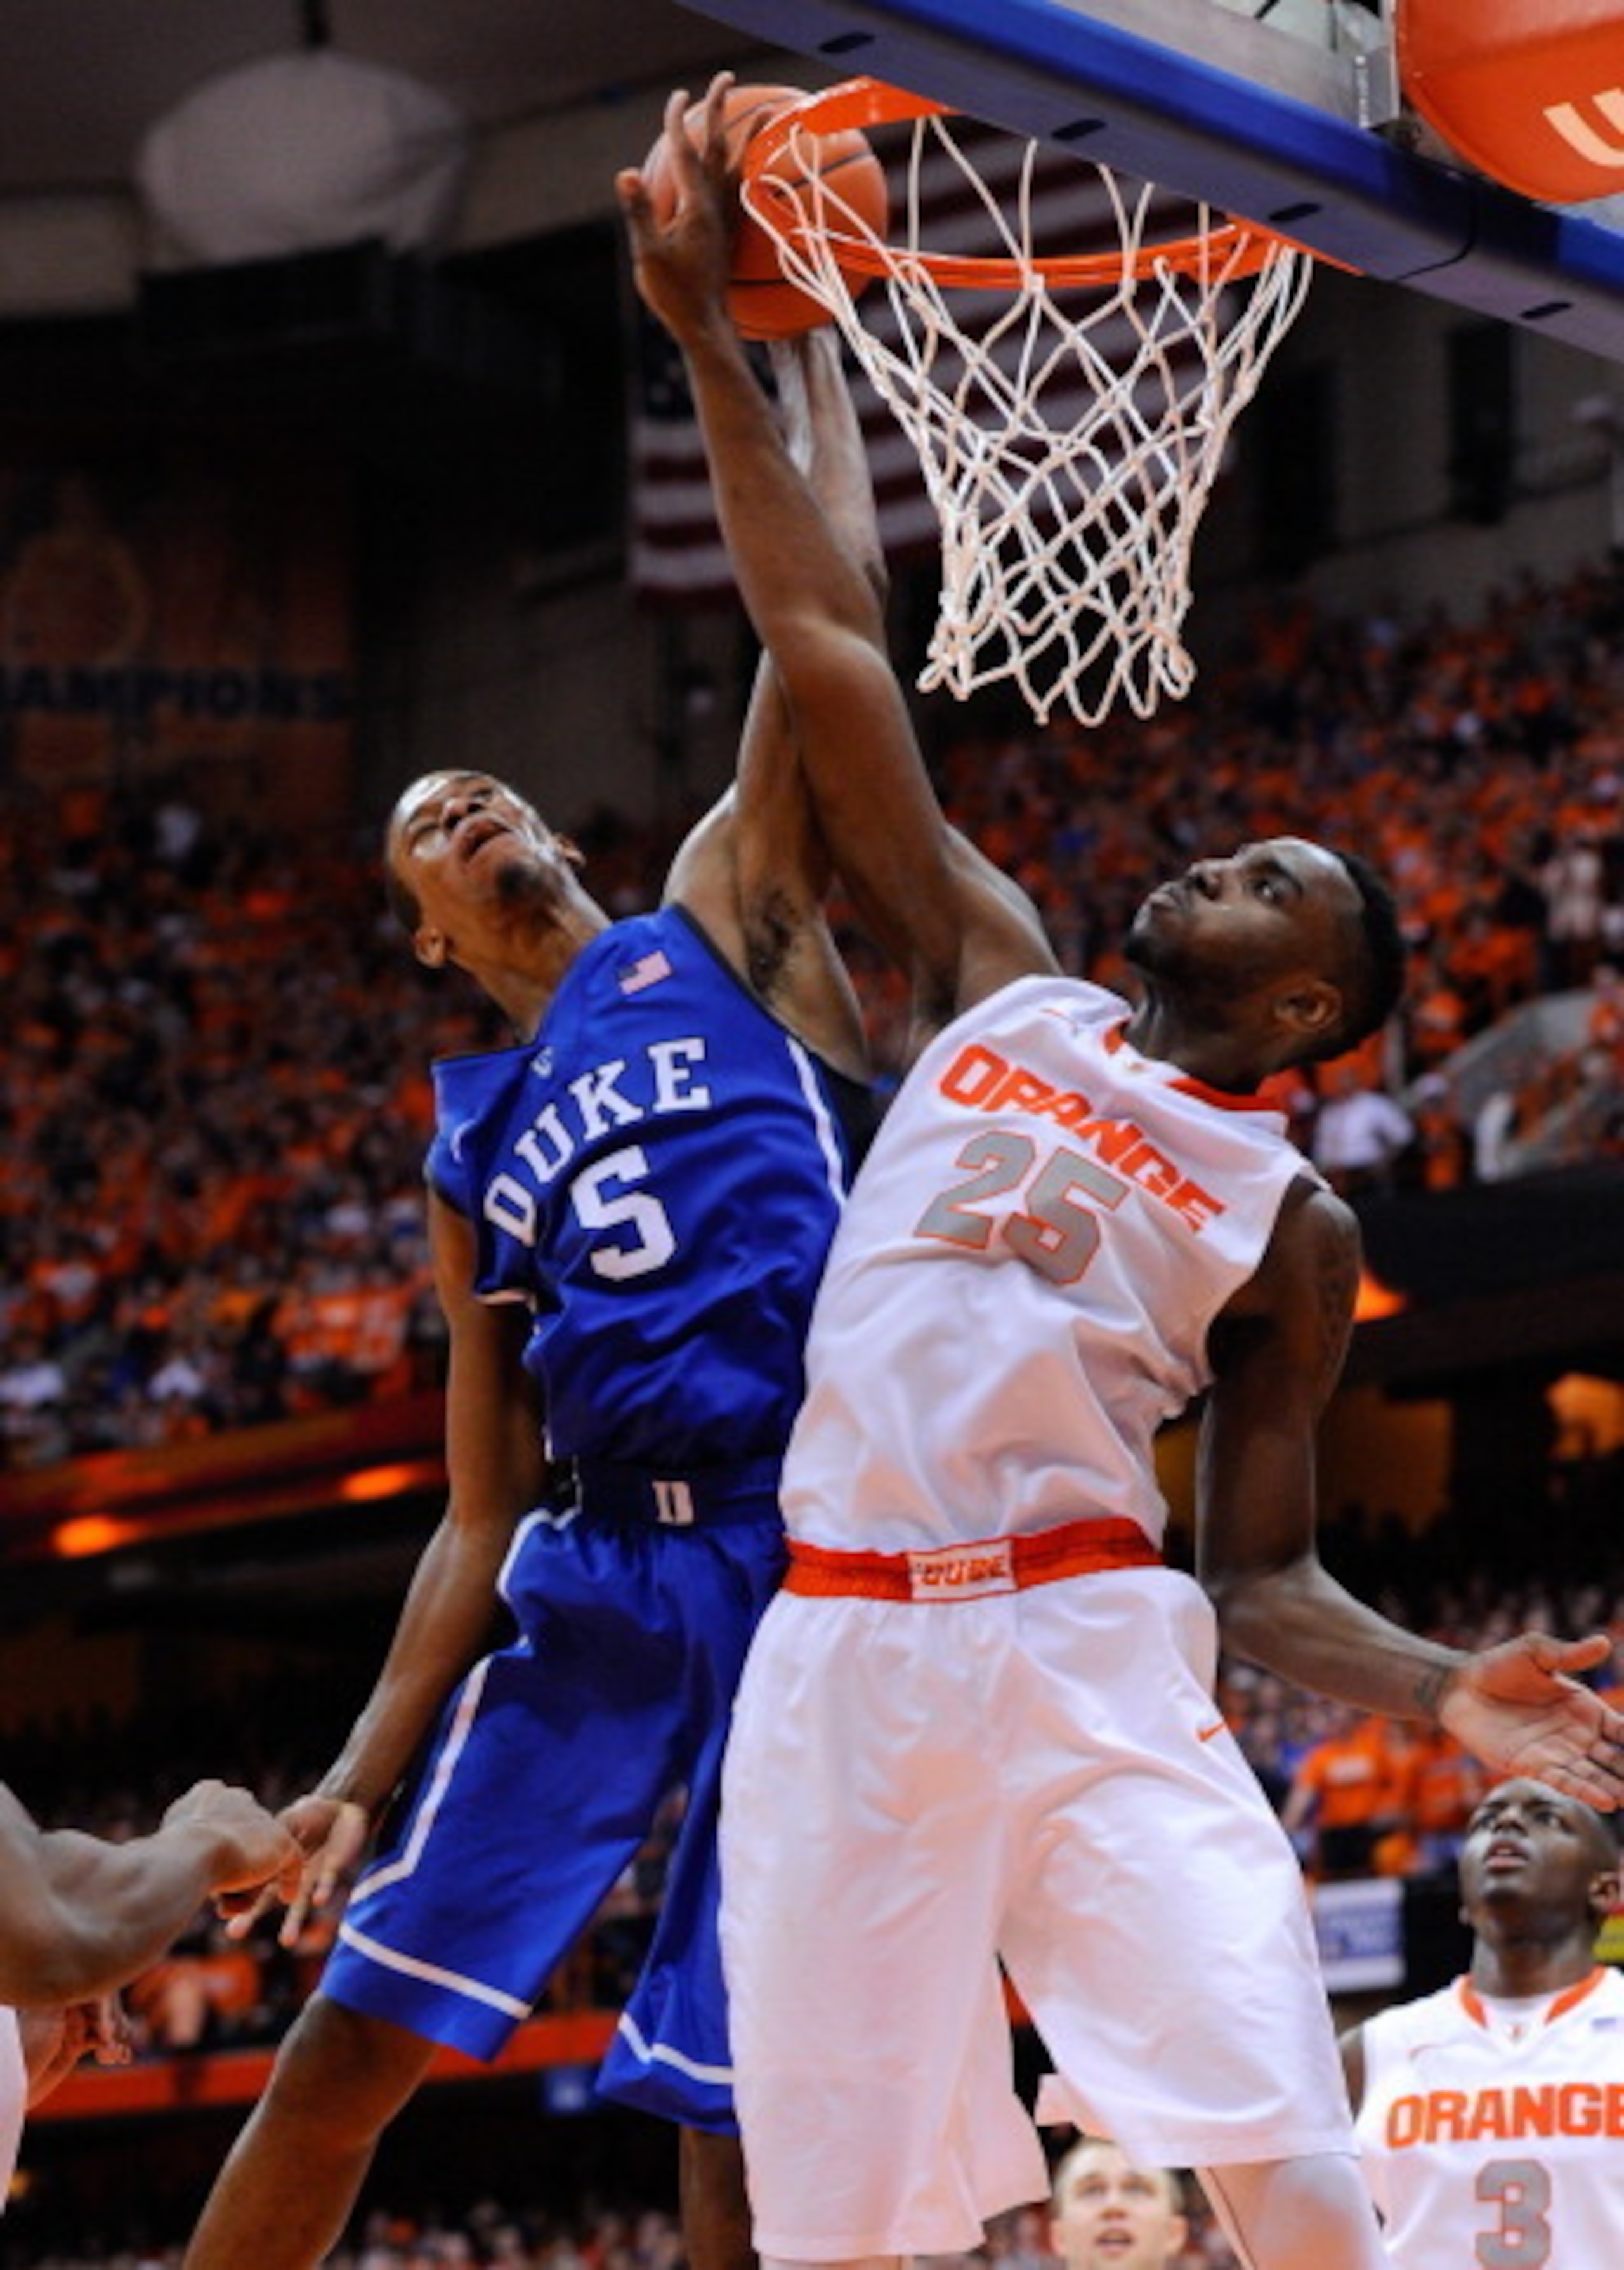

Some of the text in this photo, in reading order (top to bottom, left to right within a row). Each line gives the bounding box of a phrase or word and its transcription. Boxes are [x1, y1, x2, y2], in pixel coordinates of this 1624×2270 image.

[483, 1037, 711, 1247] DUKE
[570, 1145, 676, 1282] 5
[914, 1129, 1131, 1287] 25
[1475, 2159, 1552, 2270] 3
